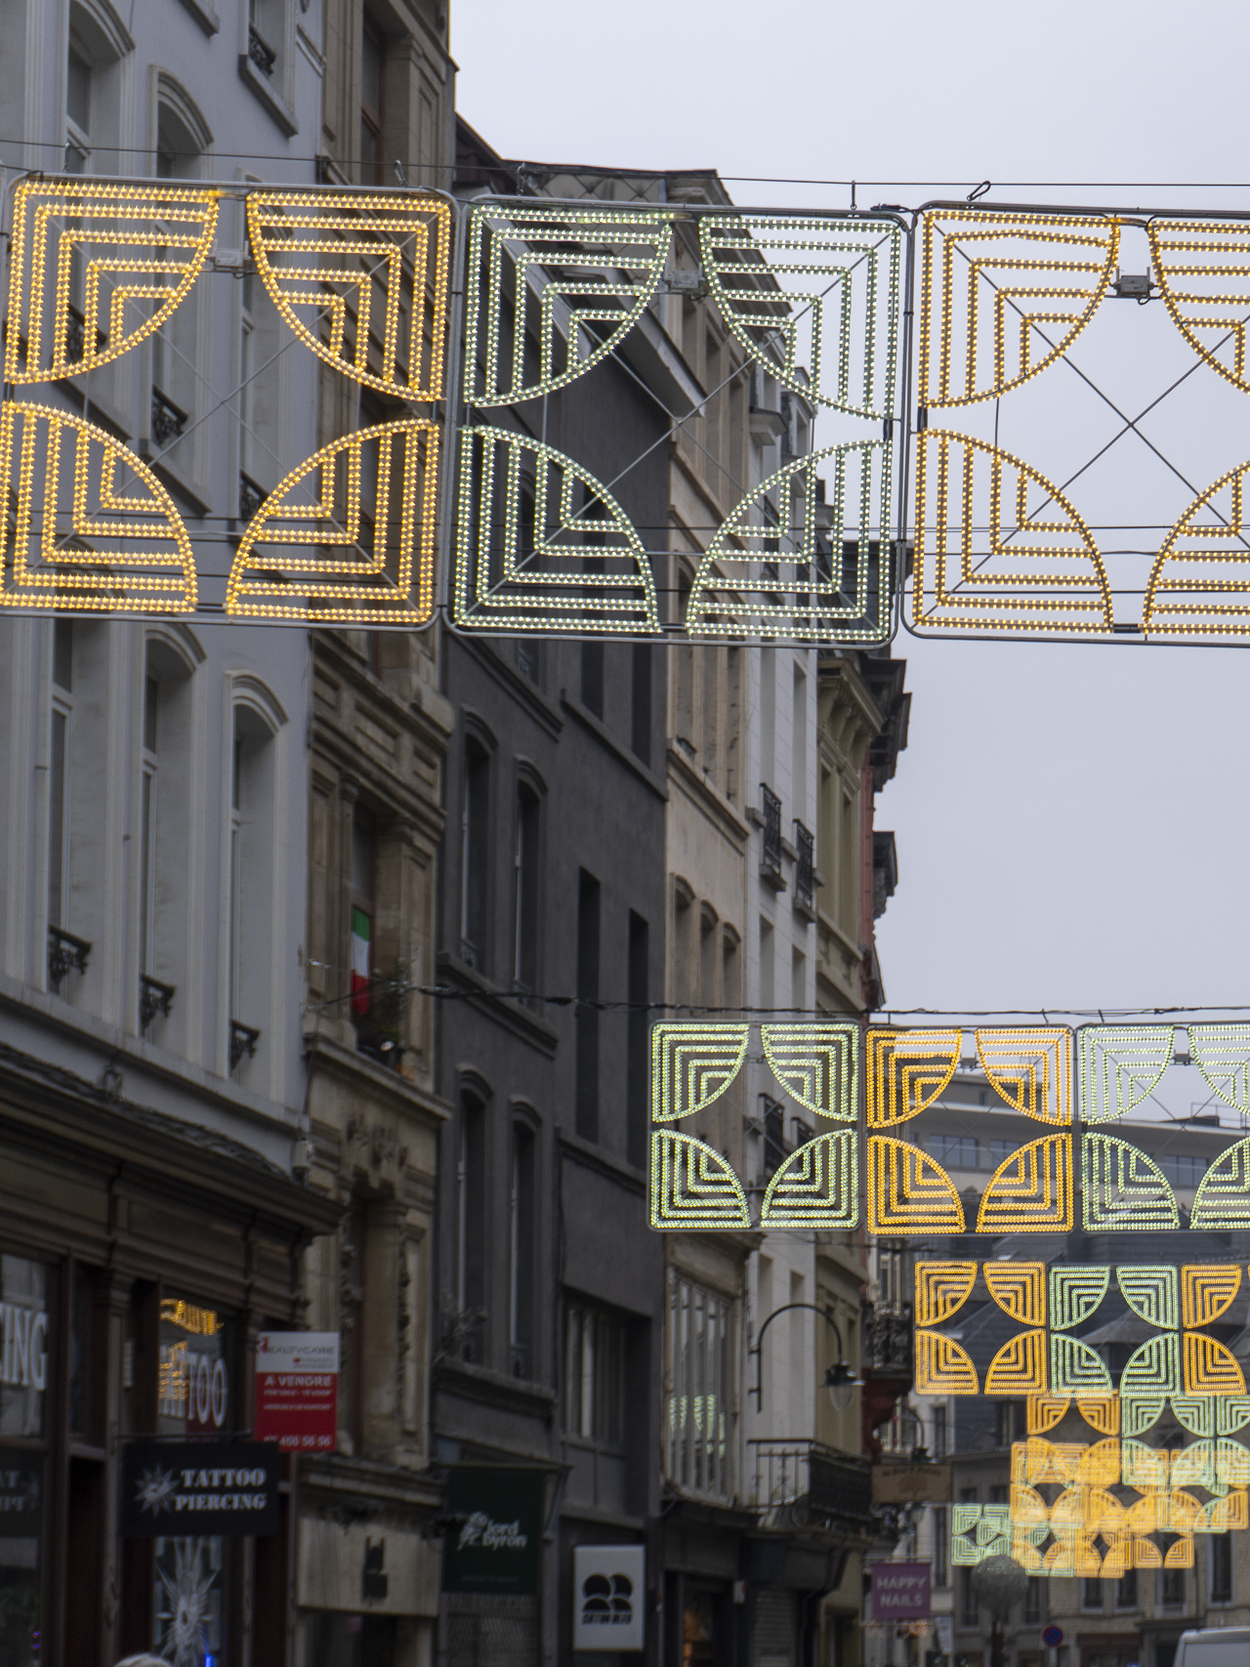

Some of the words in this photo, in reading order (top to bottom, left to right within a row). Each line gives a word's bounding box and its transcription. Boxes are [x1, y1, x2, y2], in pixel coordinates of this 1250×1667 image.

[278, 1375, 332, 1387] VENDRE
[302, 1435, 316, 1447] 56
[317, 1435, 332, 1447] 56
[181, 1467, 267, 1488] TATTOO
[175, 1493, 267, 1511] PIERCING
[486, 1518, 520, 1537] lord
[482, 1533, 528, 1551] byron
[877, 1576, 927, 1590] HAPPY
[880, 1593, 924, 1607] NAILS
